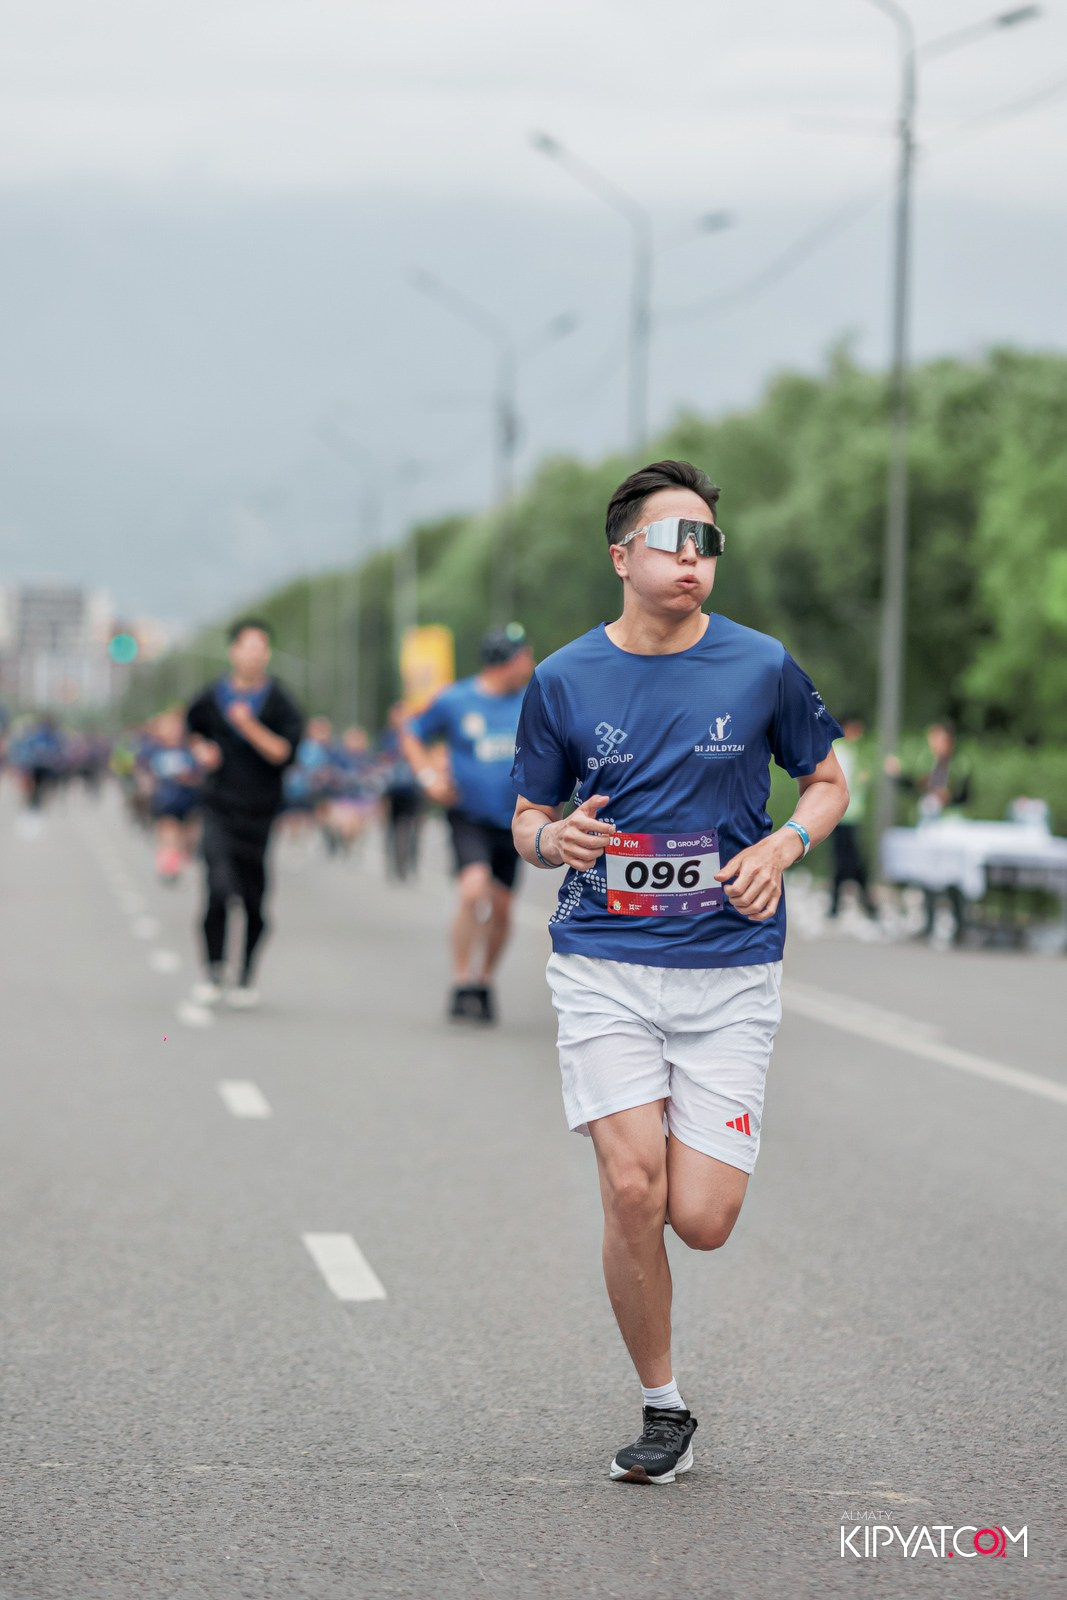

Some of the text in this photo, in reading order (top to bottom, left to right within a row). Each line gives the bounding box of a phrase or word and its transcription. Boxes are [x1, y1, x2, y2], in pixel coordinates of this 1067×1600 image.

[705, 744, 745, 752] JULDYZAI
[600, 753, 634, 767] GROUP
[609, 837, 639, 849] 10 KM
[677, 840, 700, 848] GROUP
[625, 859, 702, 890] 096
